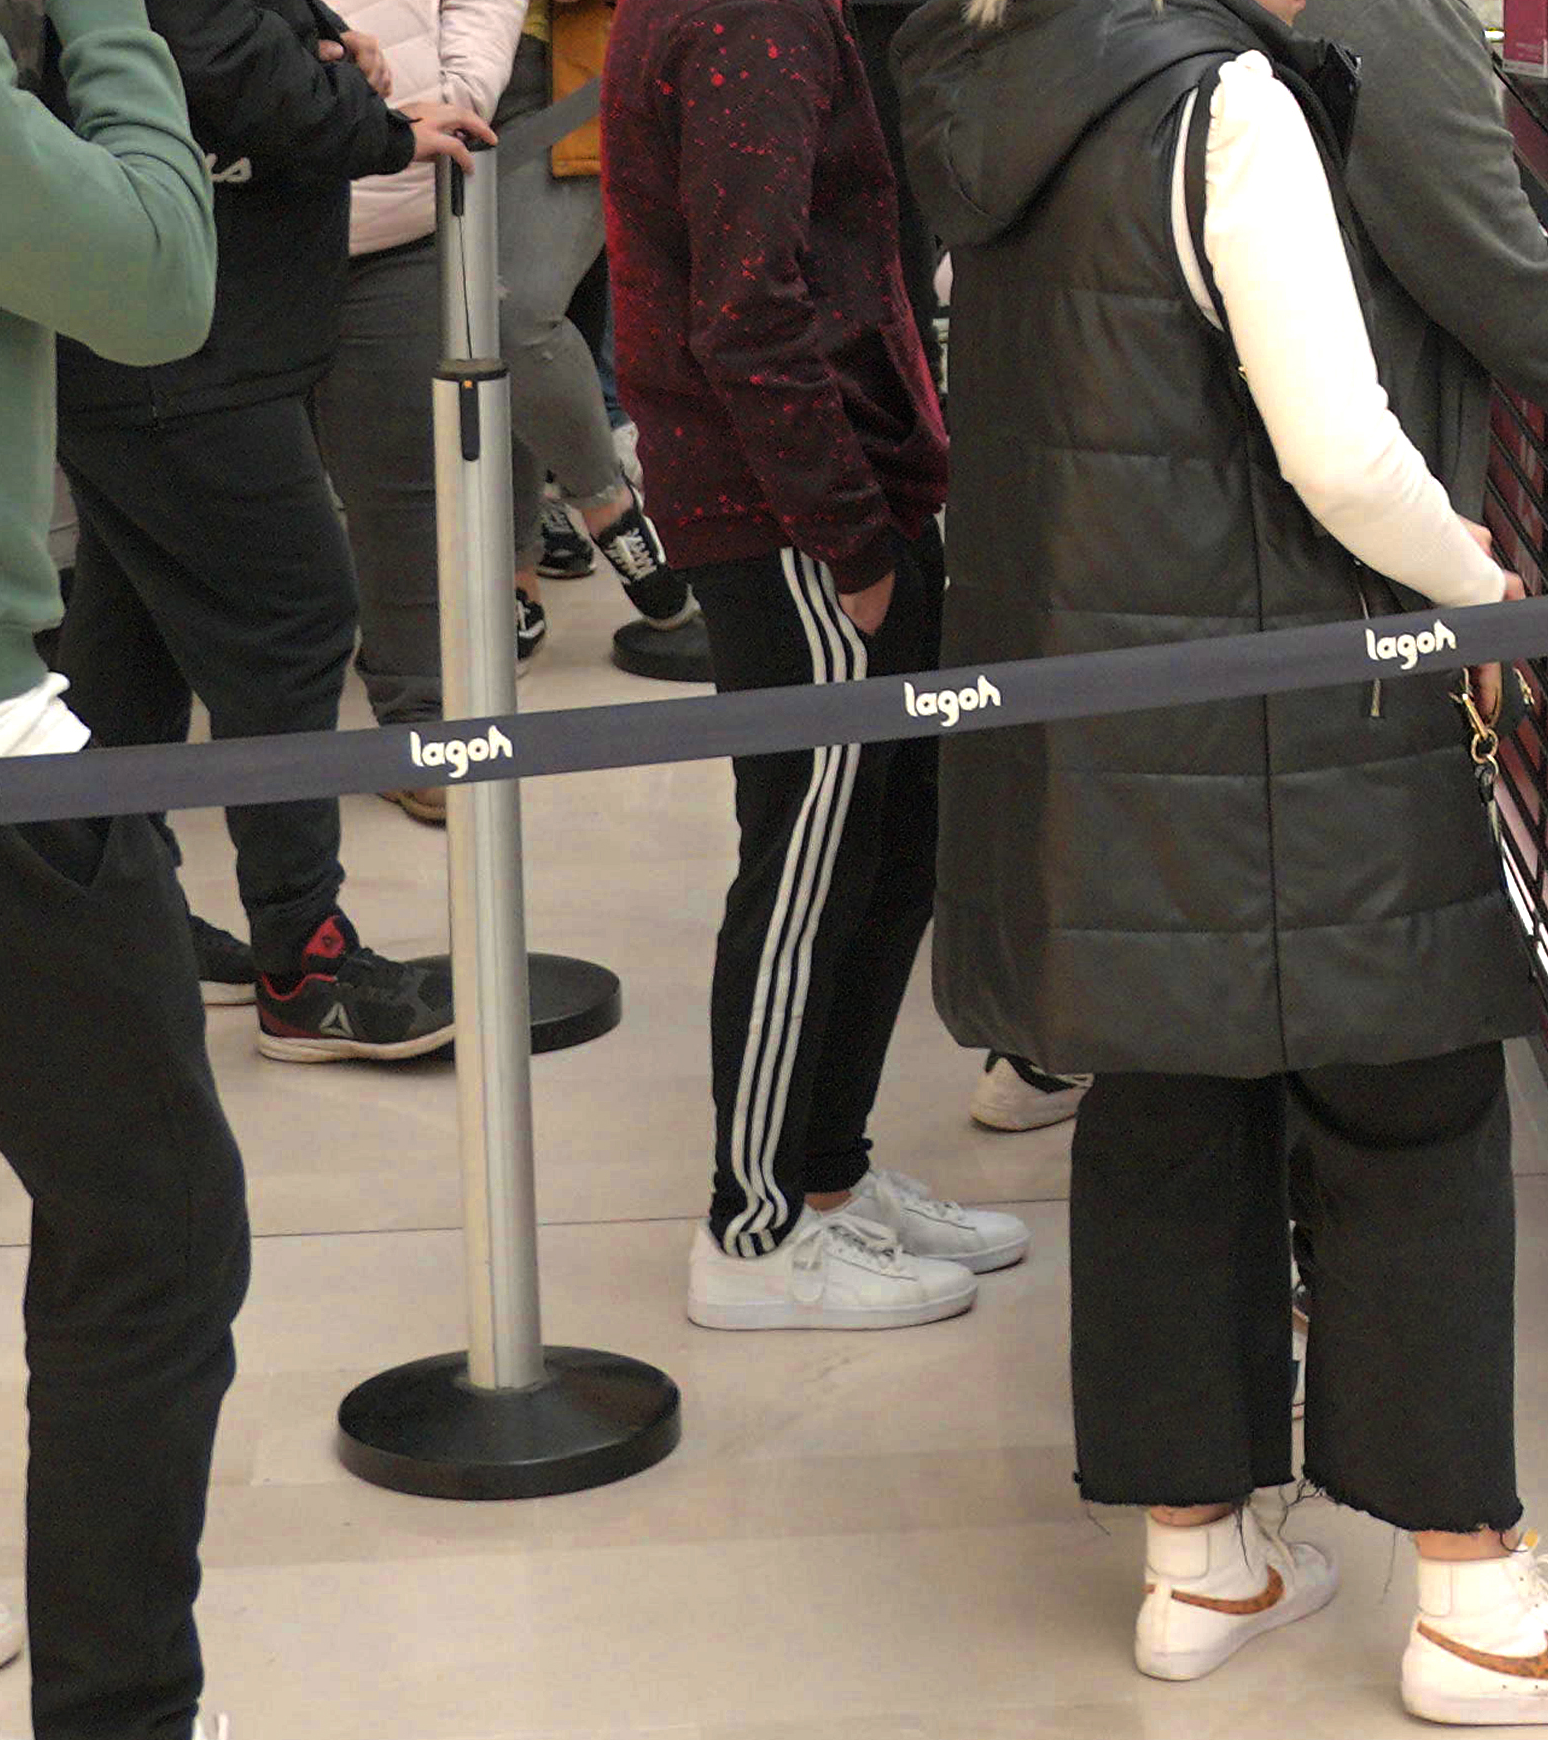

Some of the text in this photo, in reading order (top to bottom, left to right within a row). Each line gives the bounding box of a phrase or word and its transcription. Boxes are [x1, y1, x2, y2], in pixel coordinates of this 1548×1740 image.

[1365, 619, 1457, 671] lagoh
[904, 674, 1001, 727] lagoh
[410, 725, 513, 779] lagoh
